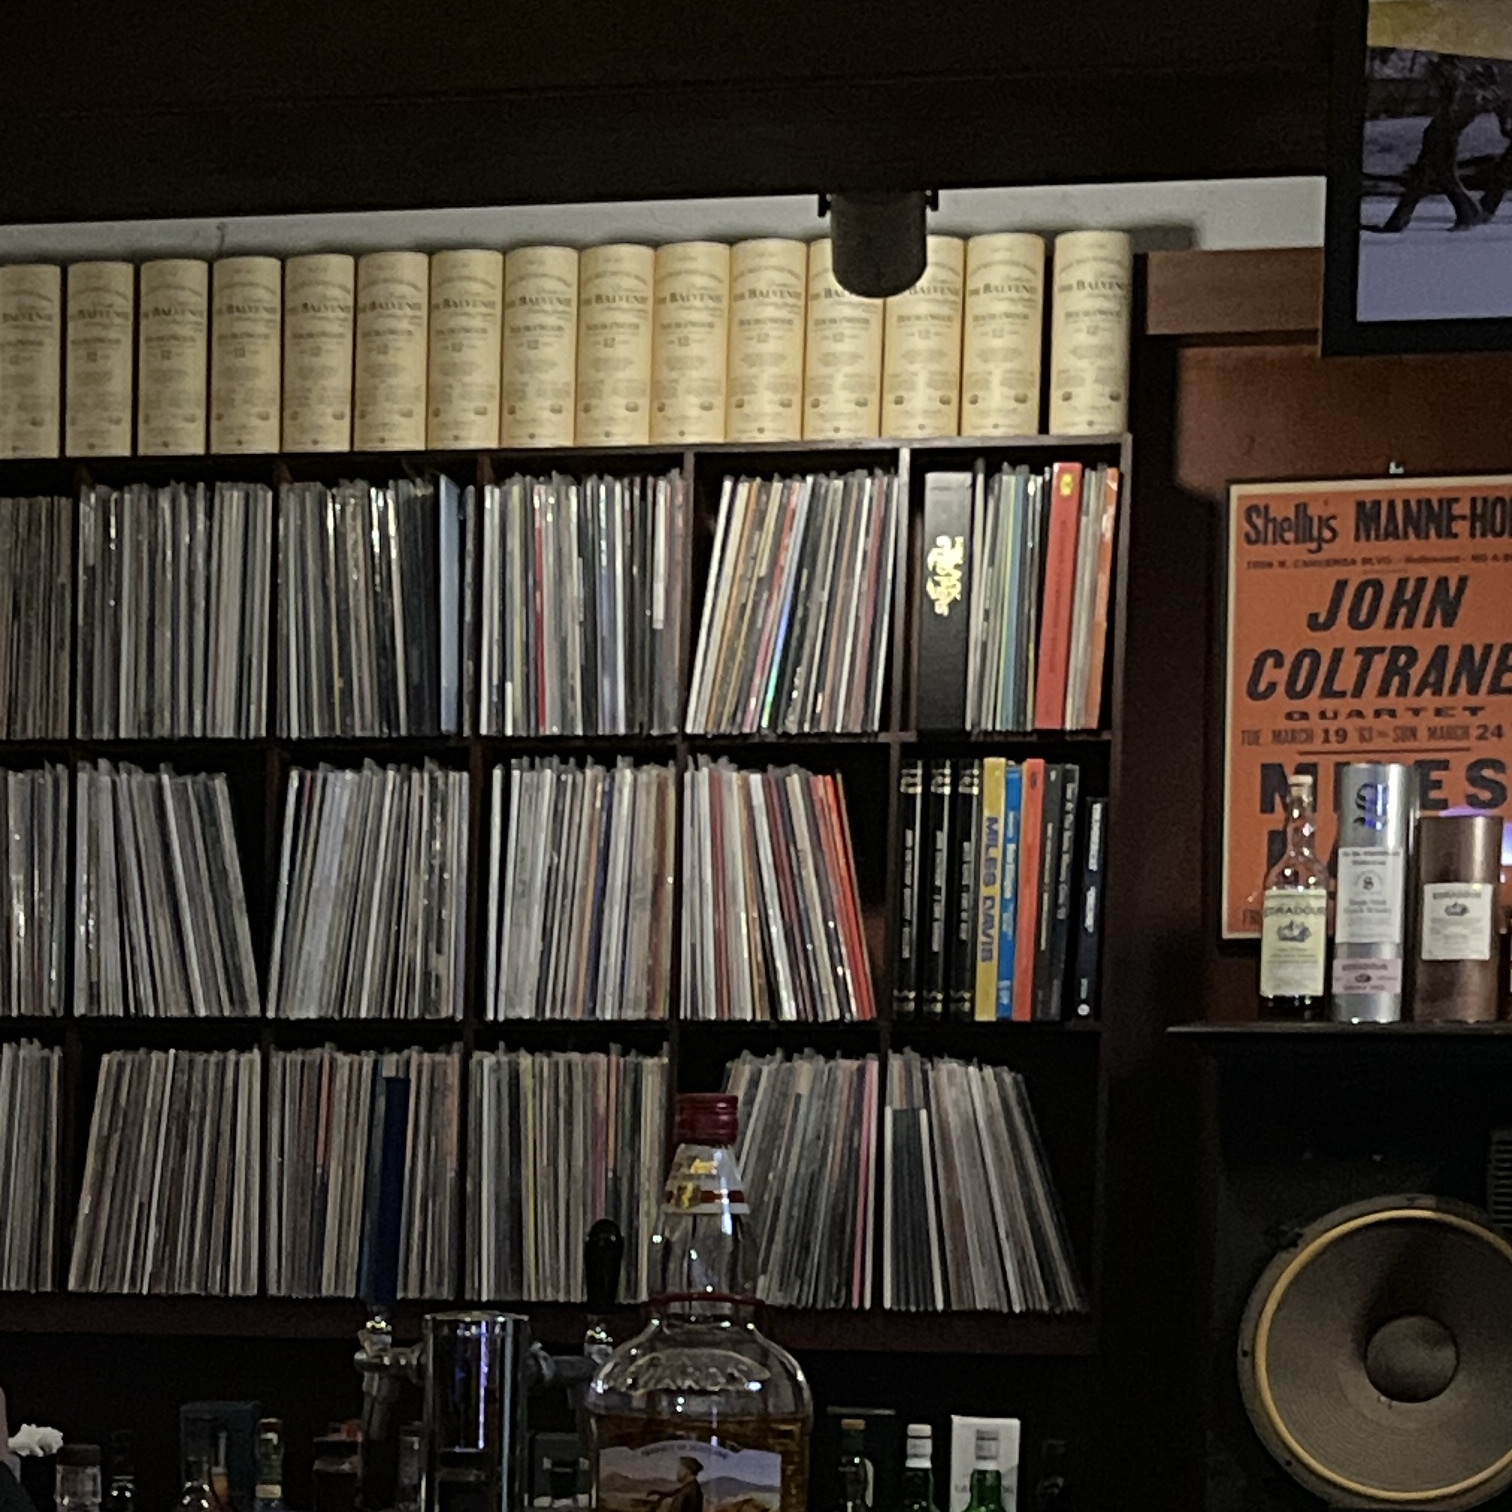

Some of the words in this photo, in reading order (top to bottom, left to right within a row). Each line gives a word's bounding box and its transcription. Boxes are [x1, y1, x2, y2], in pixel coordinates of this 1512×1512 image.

[1306, 574, 1470, 633] JOHN
[1245, 643, 1512, 702] COLTRANE
[1284, 705, 1486, 722] QUARTET
[1321, 726, 1348, 745] 19
[1475, 723, 1503, 741] 24
[1260, 756, 1508, 815] MES
